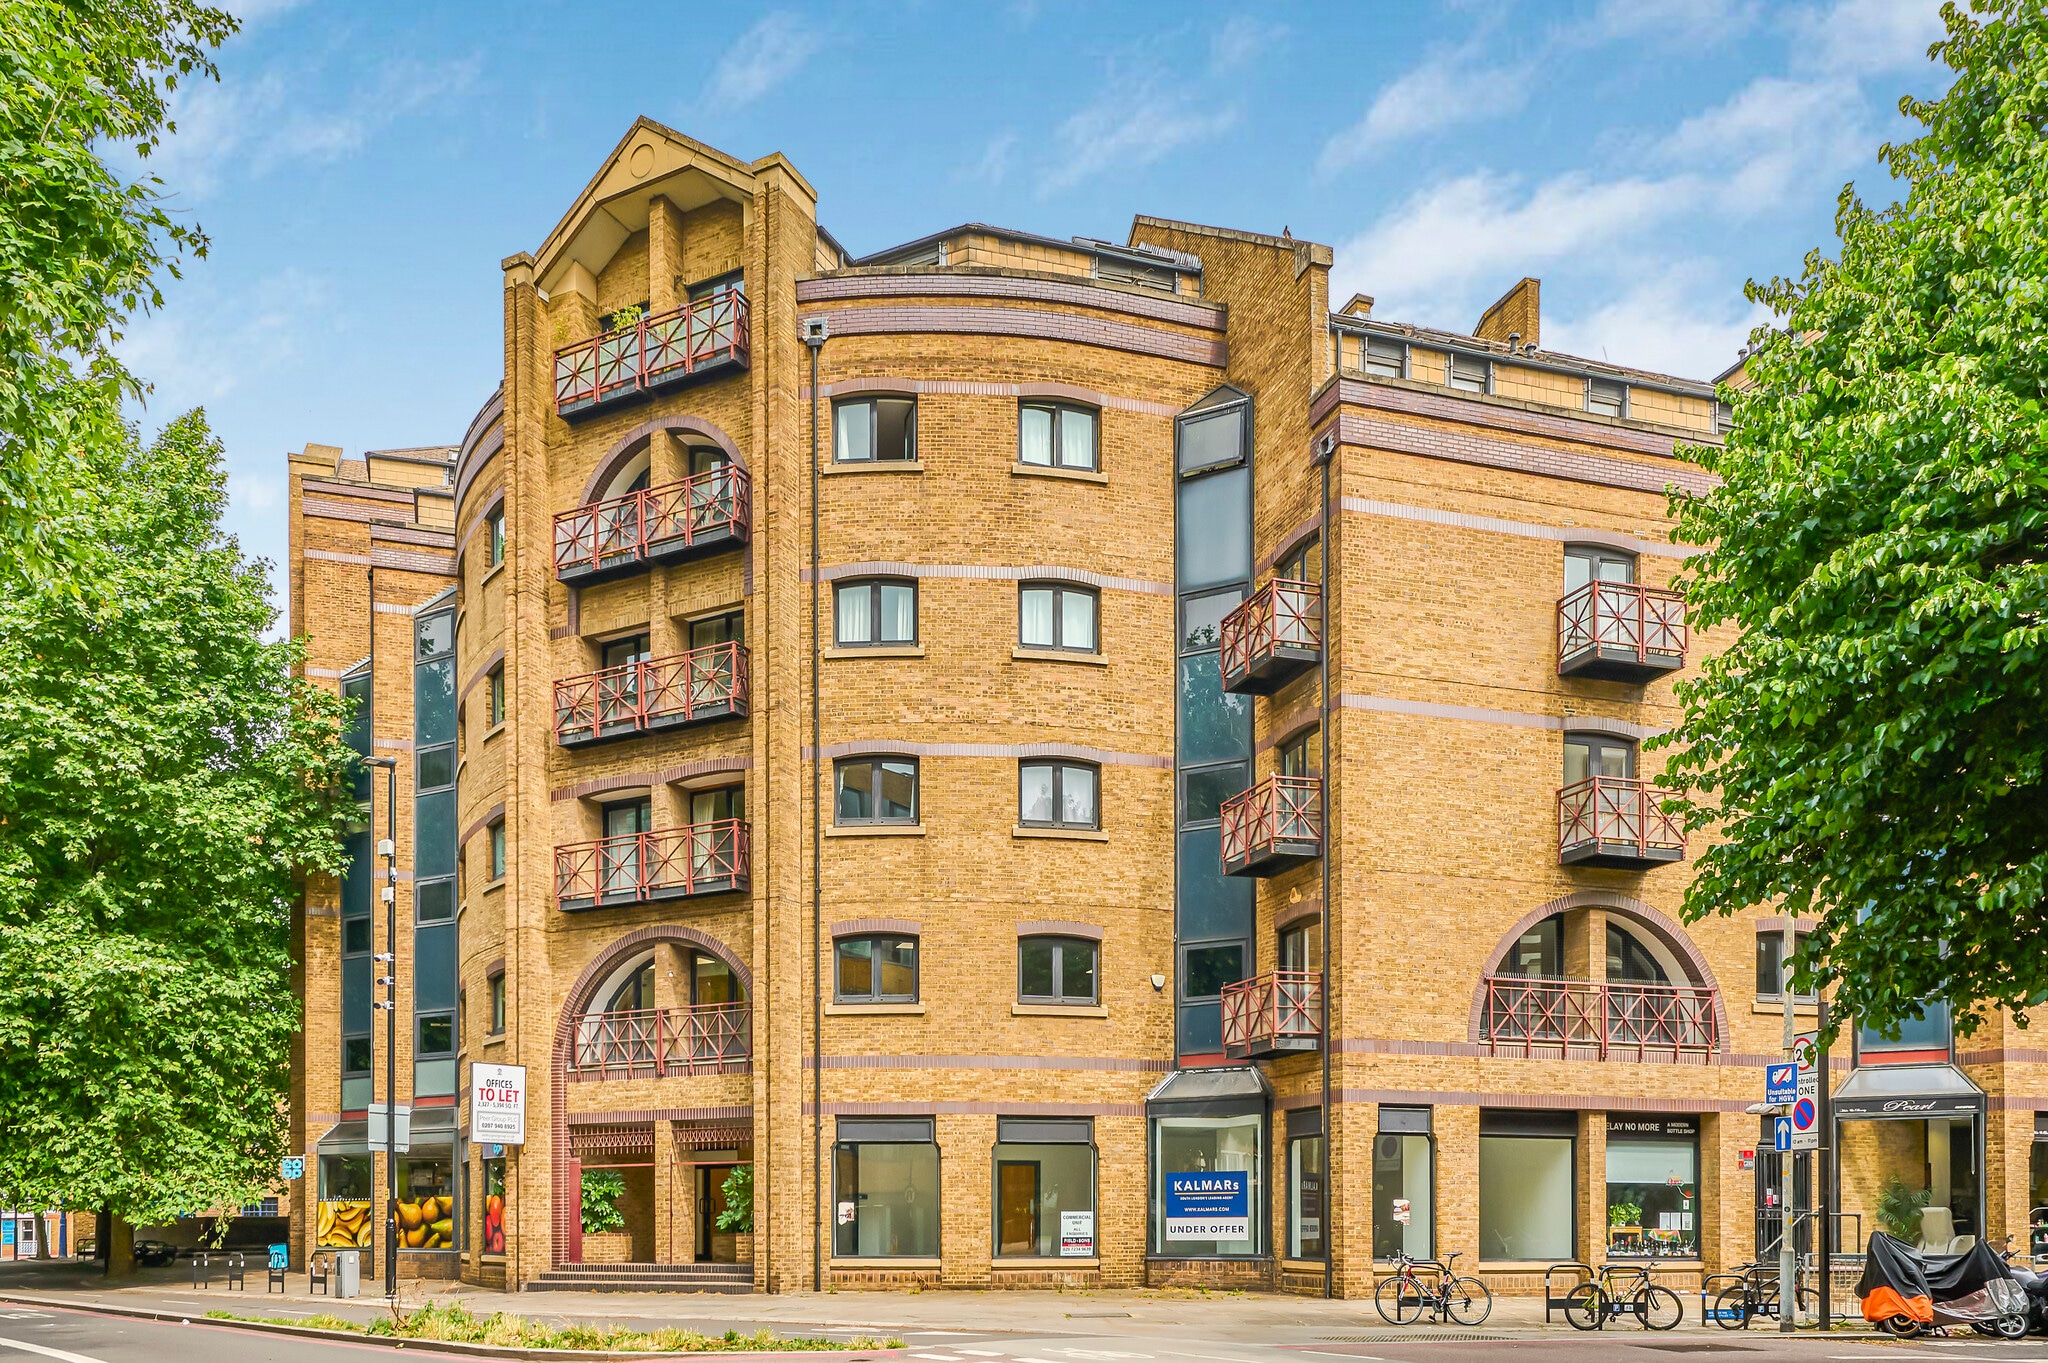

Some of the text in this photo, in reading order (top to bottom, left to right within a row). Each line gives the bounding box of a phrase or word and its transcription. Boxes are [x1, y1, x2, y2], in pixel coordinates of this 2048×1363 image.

[486, 1079, 513, 1089] OFFICES
[1798, 1076, 1819, 1084] trolle
[479, 1087, 520, 1103] TO LET
[1767, 1087, 1796, 1096] Unsuitable
[1798, 1085, 1815, 1095] ONE
[1768, 1094, 1794, 1103] for HGVs
[1882, 1099, 1937, 1112] Pearl
[1625, 1122, 1636, 1131] NO
[1637, 1122, 1660, 1132] MORE
[1174, 1180, 1239, 1191] KALMARs
